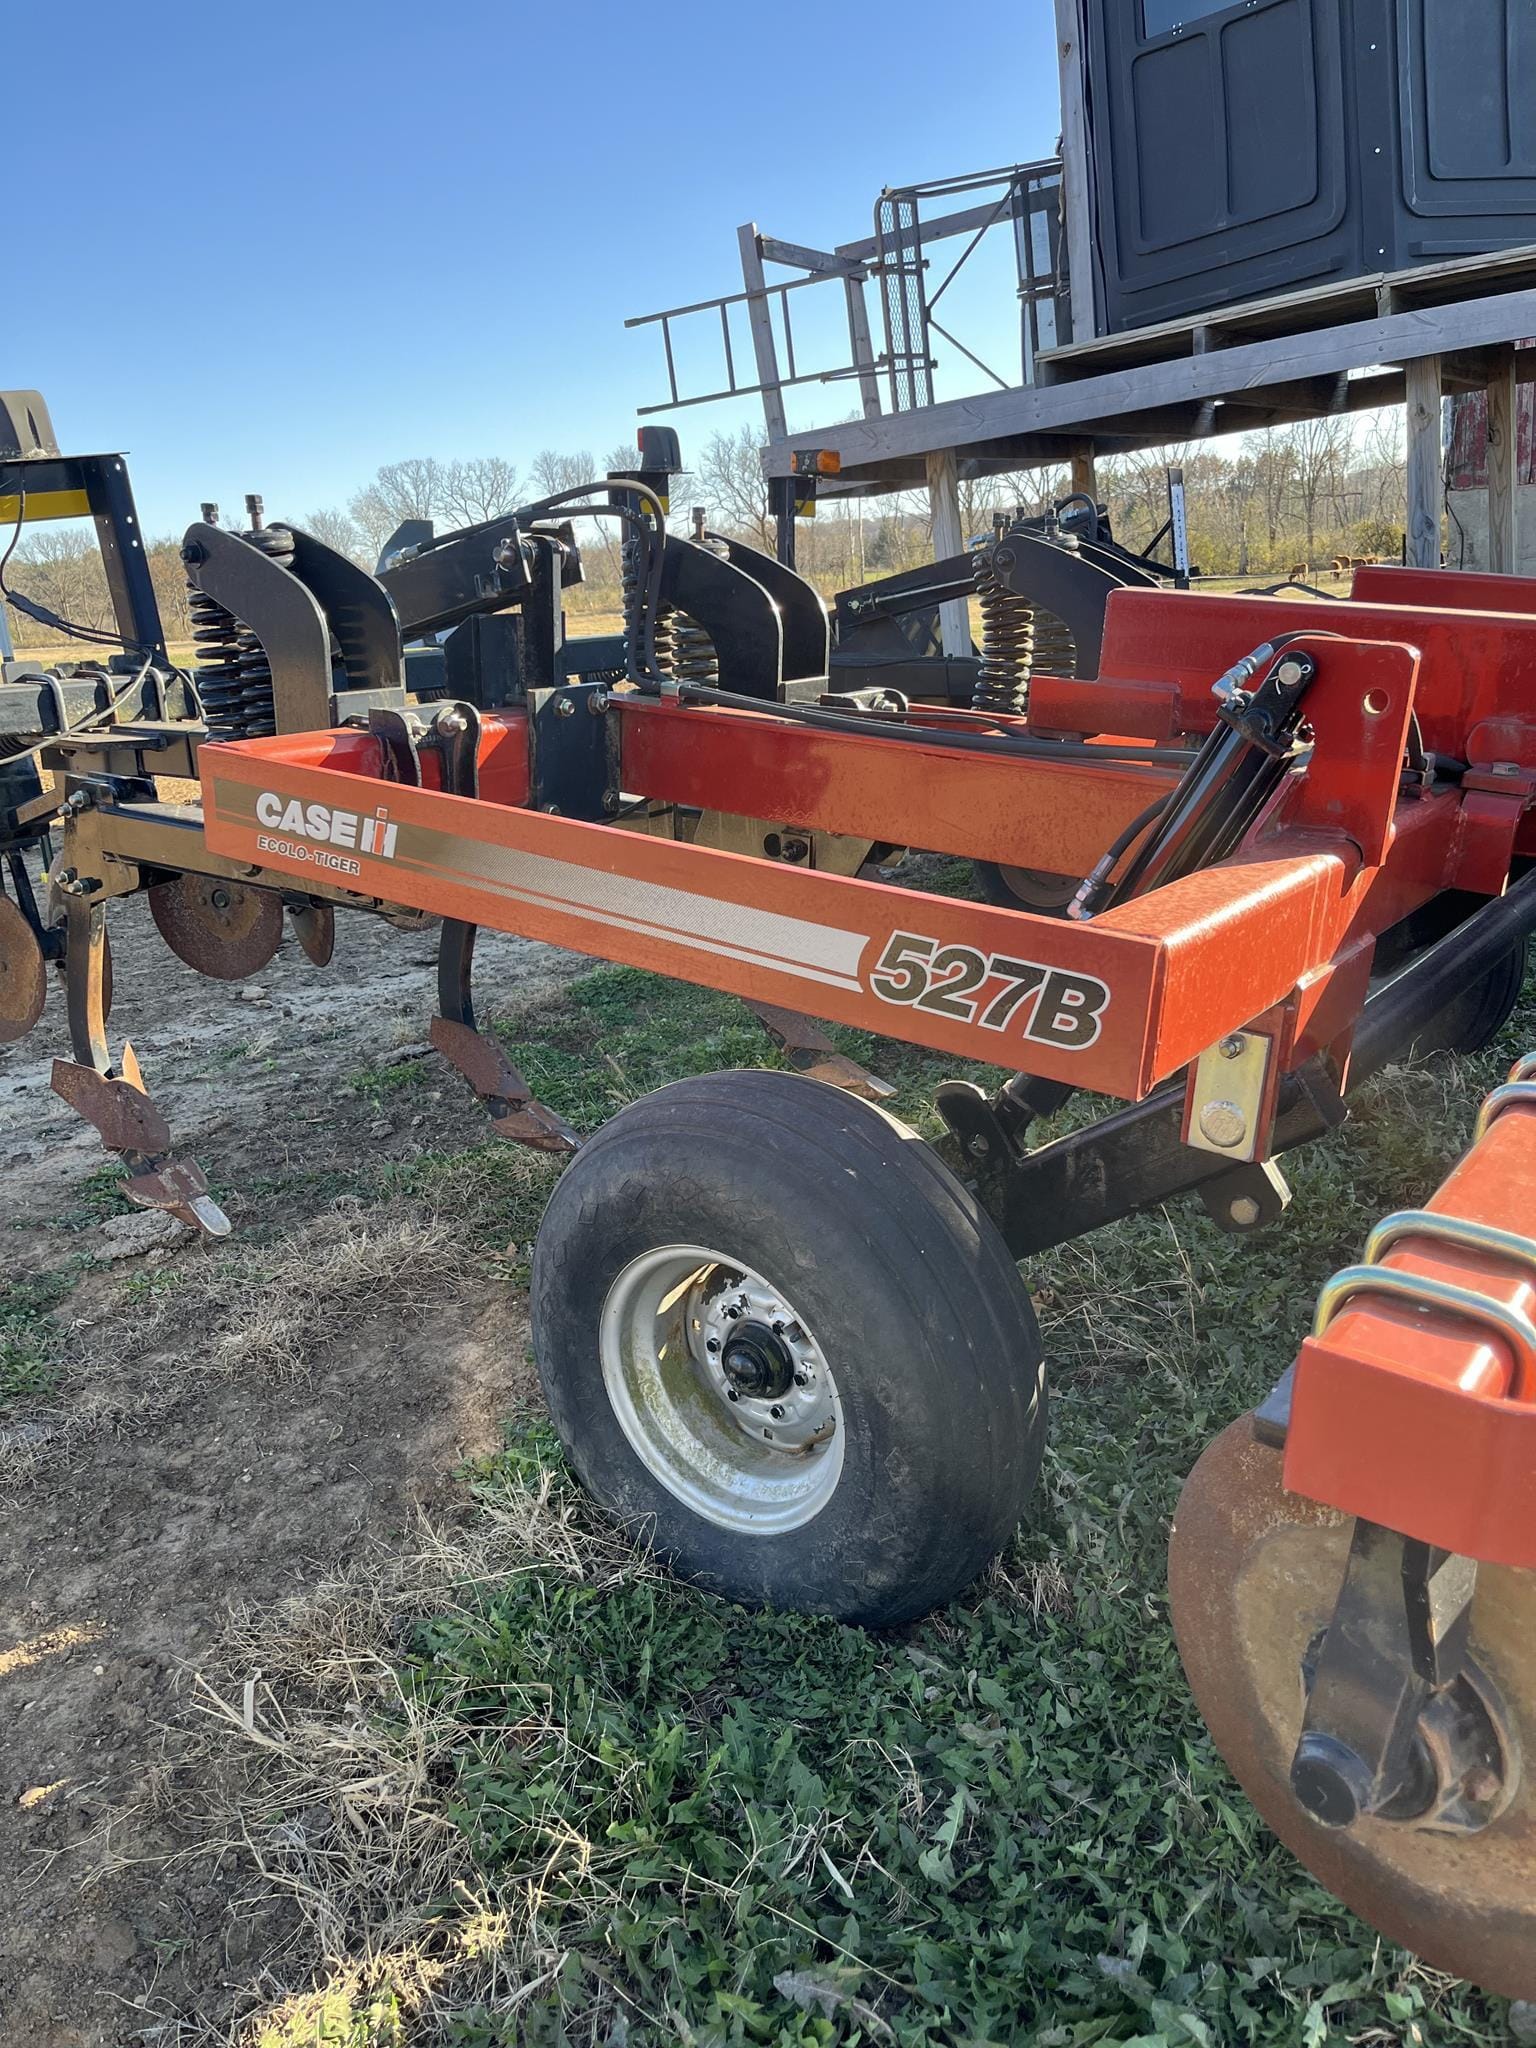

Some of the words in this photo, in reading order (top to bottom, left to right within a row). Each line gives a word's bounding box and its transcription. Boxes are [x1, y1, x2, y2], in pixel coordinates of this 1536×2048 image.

[256, 792, 358, 849] CASE
[256, 834, 361, 876] ECOLO-TIGER
[869, 929, 1111, 1051] 527B
